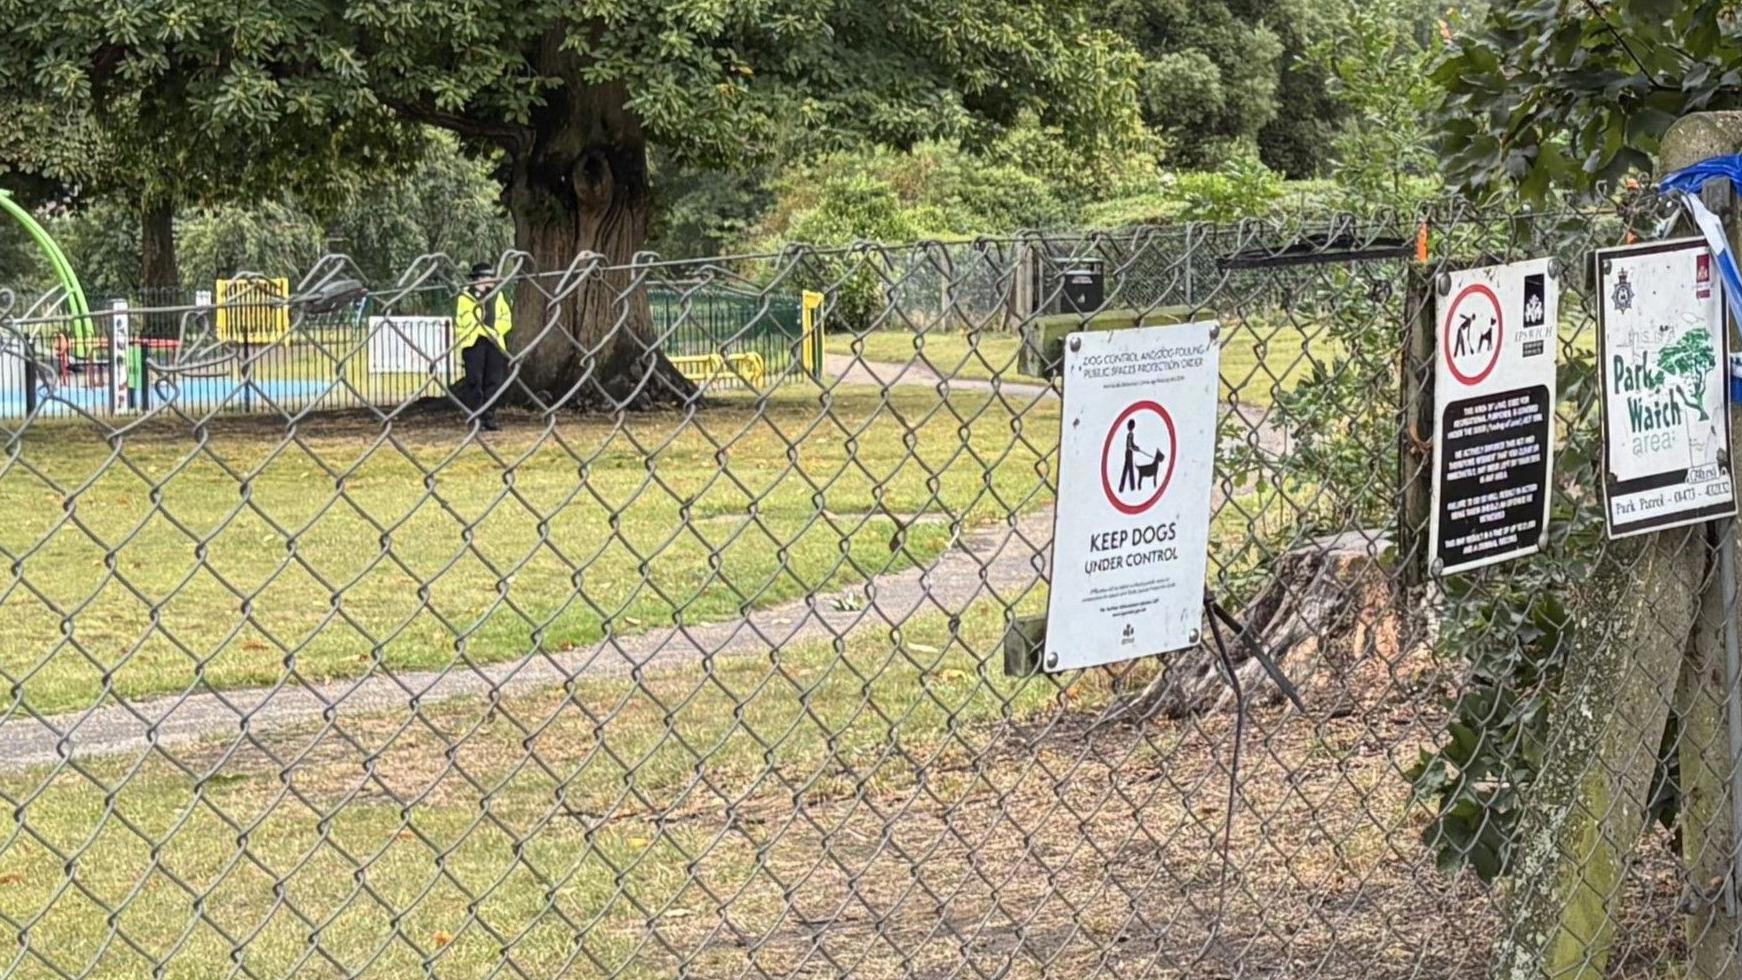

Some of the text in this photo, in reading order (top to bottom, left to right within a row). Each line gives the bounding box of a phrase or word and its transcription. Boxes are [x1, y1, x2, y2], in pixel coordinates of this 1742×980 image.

[1083, 364, 1110, 379] PUBLIC
[1103, 351, 1140, 365] CONTROL
[1614, 350, 1656, 395] Park
[1627, 388, 1682, 433] Watch
[1616, 500, 1636, 515] Park
[1089, 522, 1177, 553] KEEP DOGS
[1084, 547, 1178, 575] UNDER CONTROL
